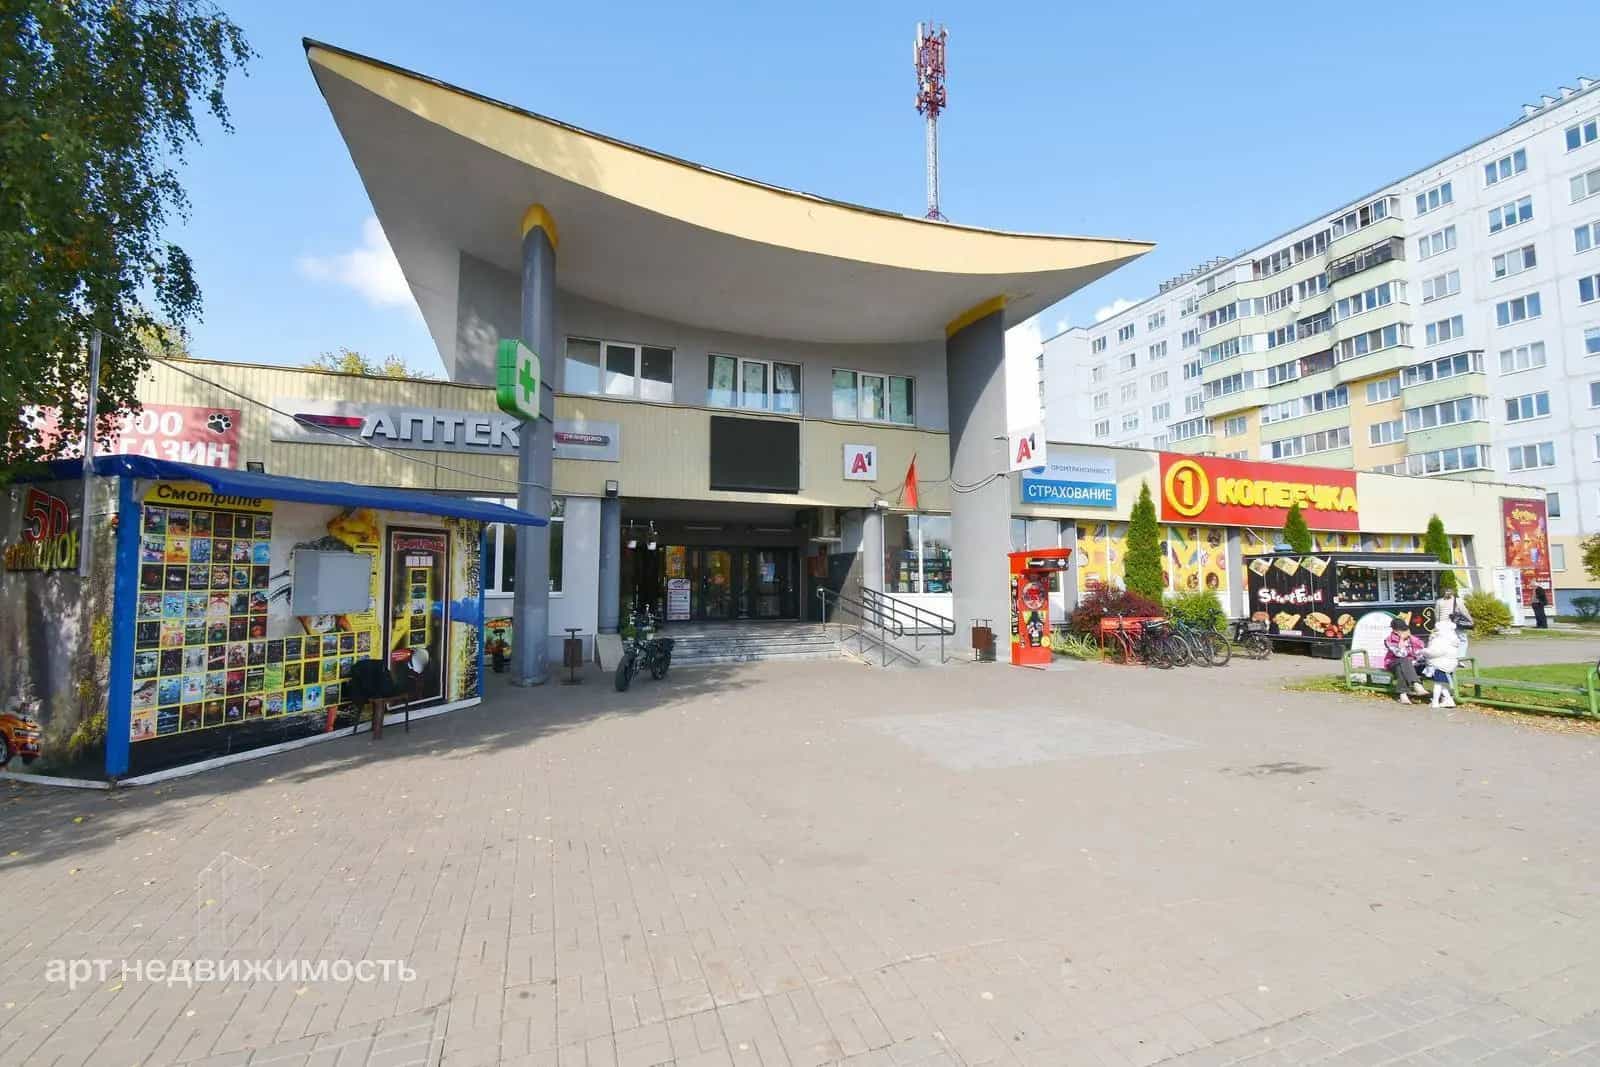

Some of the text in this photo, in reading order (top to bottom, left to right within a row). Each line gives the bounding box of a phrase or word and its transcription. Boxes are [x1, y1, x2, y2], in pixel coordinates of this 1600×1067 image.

[361, 413, 555, 450] АПТЕК
[157, 484, 262, 508] Смотрите
[1028, 484, 1113, 502] СТРАХОВАНИЕ
[1216, 476, 1359, 513] КОПЕЕЧКА
[23, 487, 70, 544] 5D
